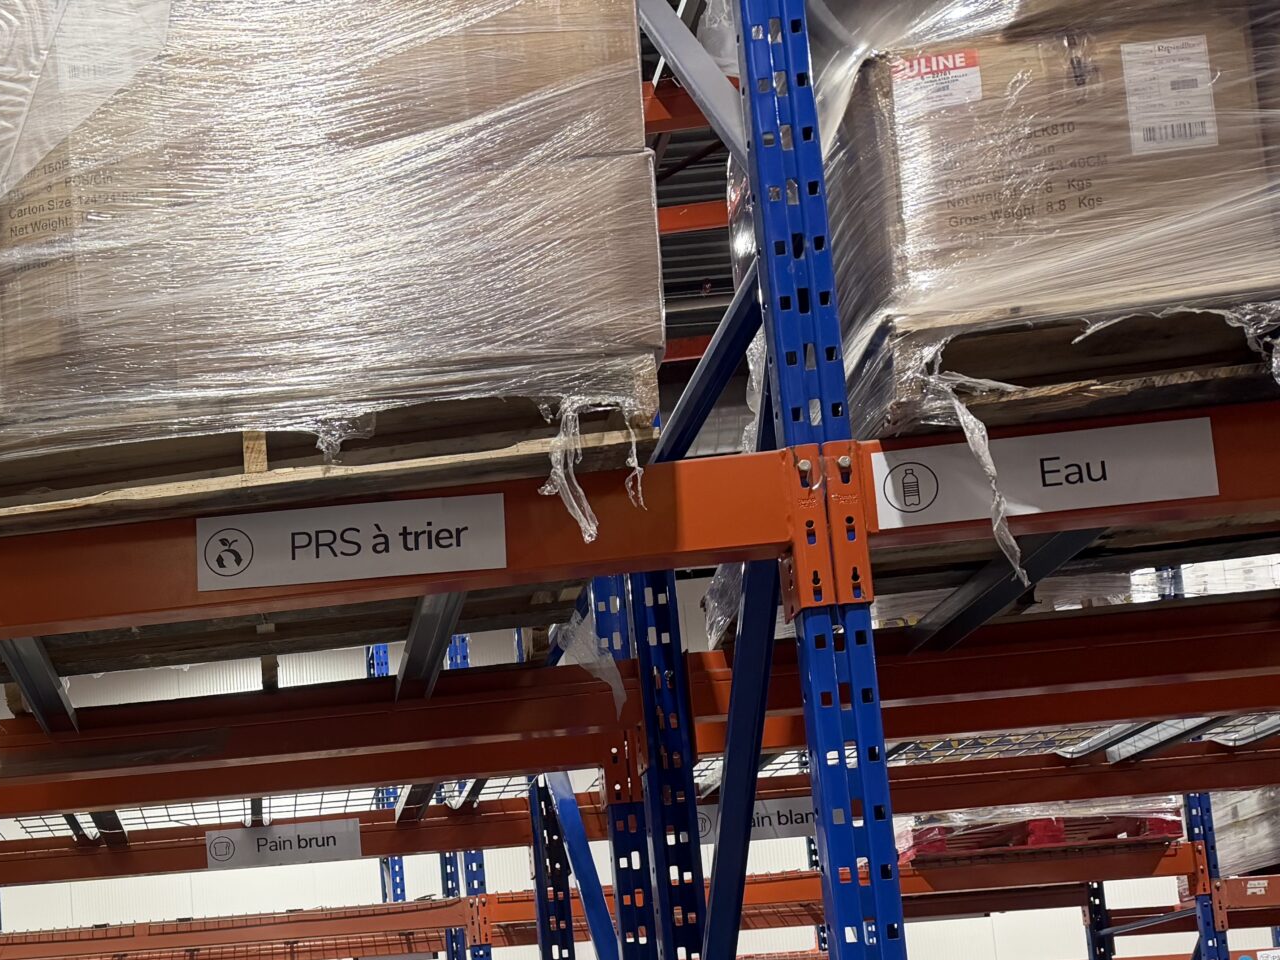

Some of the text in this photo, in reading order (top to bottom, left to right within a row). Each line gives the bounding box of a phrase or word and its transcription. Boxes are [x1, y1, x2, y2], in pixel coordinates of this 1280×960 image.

[8, 203, 45, 220] Carton
[10, 226, 30, 239] Net
[1040, 456, 1108, 488] Eau
[290, 521, 468, 561] PRS à trier
[777, 809, 815, 826] blan
[256, 834, 337, 852] Pain brun
